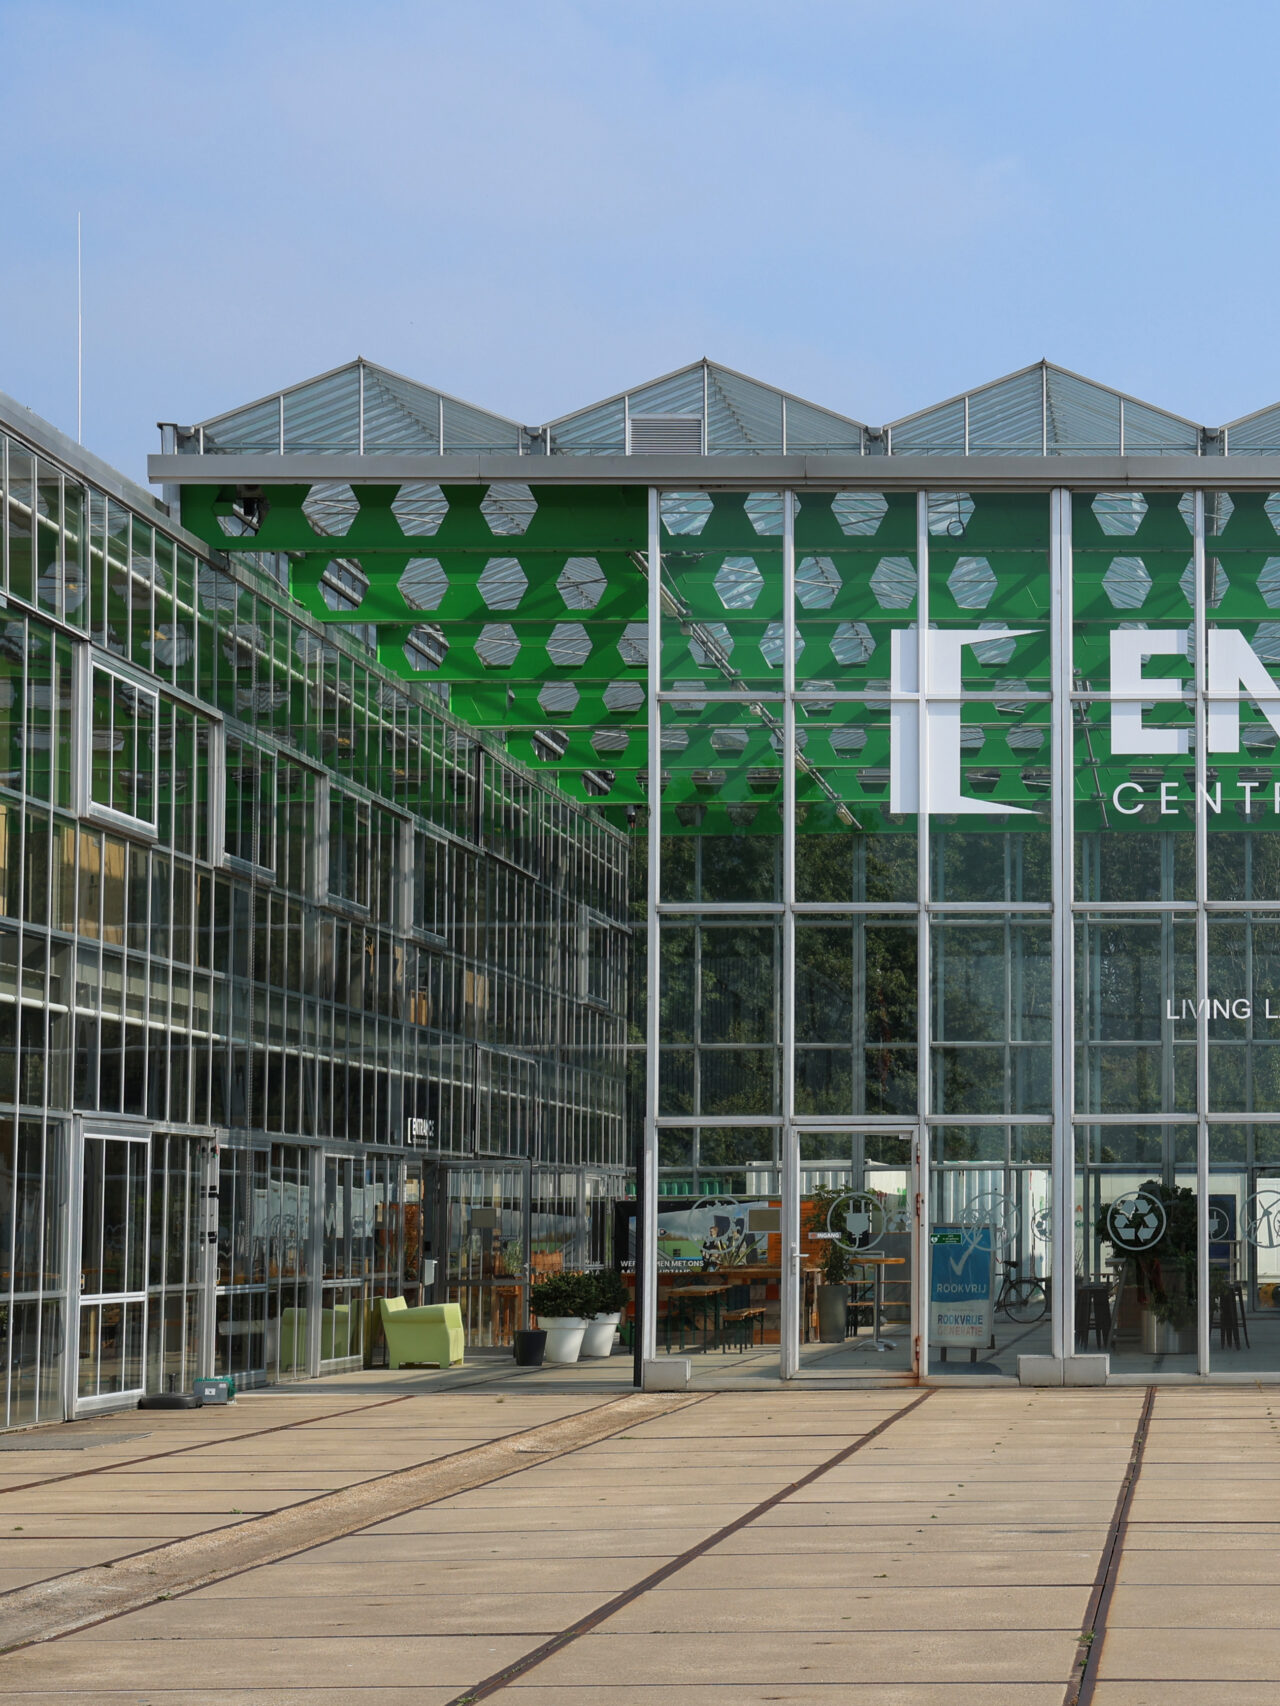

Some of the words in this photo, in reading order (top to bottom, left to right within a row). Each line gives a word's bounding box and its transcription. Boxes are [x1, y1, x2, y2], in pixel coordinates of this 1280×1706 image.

[1165, 998, 1253, 1020] LIVING
[936, 1283, 987, 1294] ROOKVRIJ
[937, 1314, 983, 1325] ROOKVRIJE
